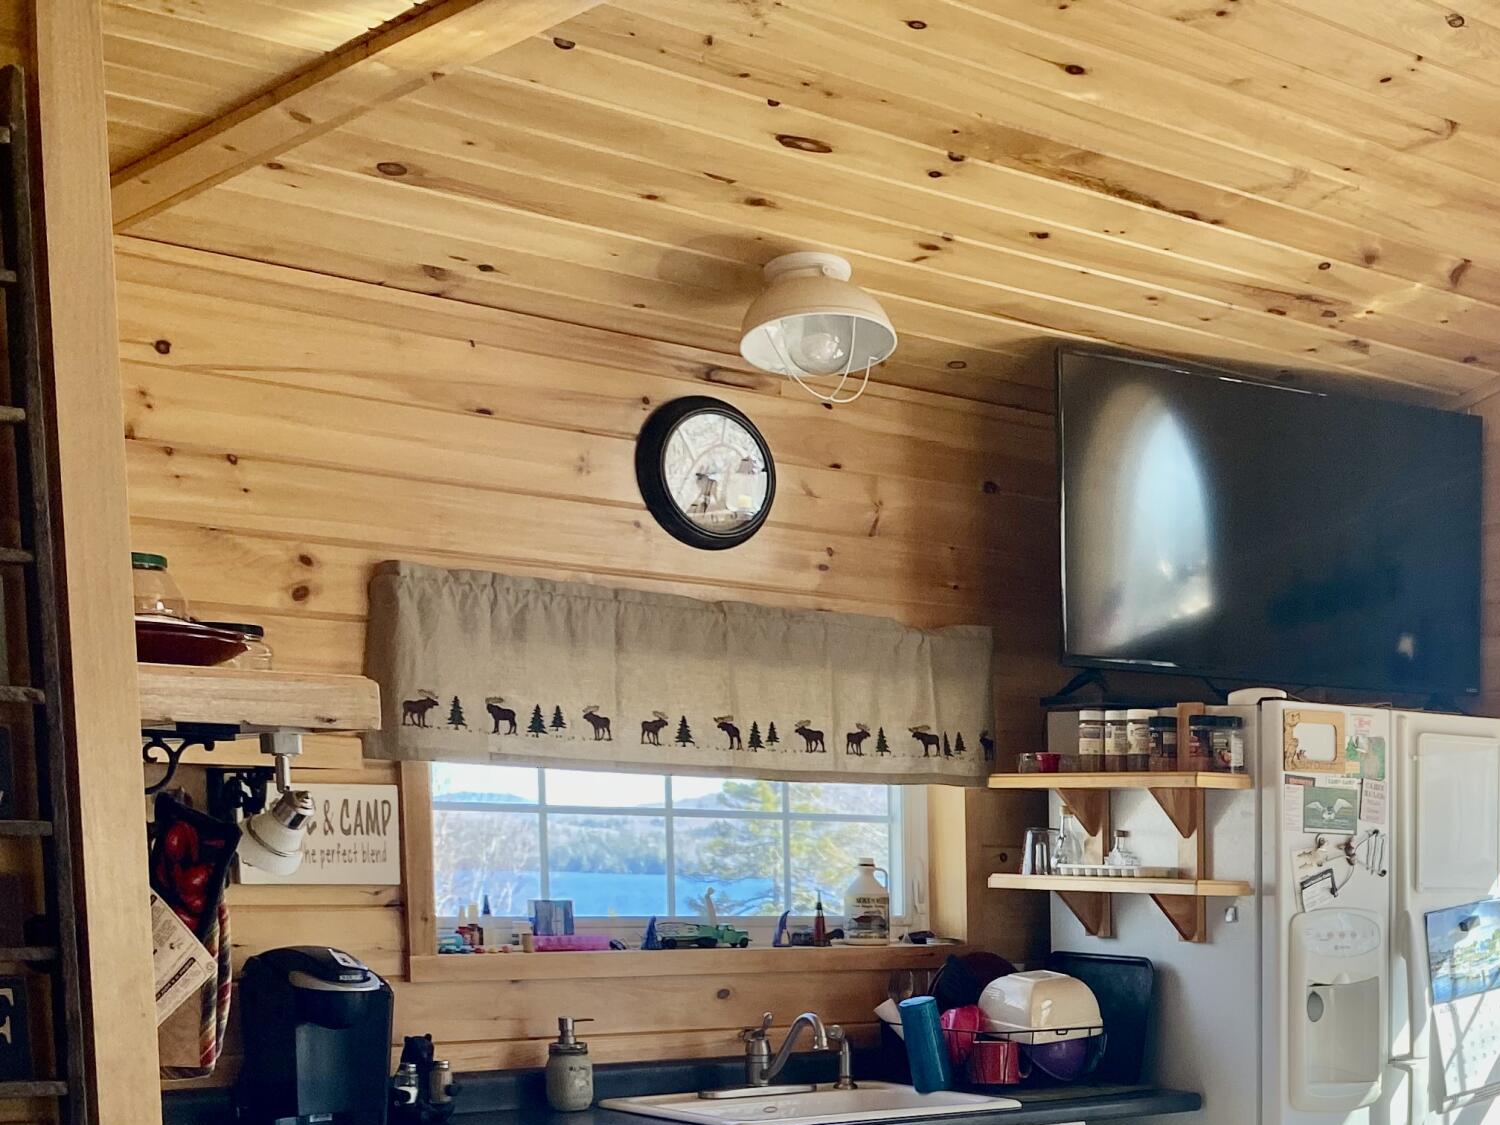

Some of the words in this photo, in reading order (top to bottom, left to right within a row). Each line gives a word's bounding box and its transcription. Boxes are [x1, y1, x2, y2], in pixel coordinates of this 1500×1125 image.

[323, 799, 335, 836] &
[339, 797, 392, 837] CAMP
[320, 841, 358, 870] perfect
[361, 840, 387, 864] blend
